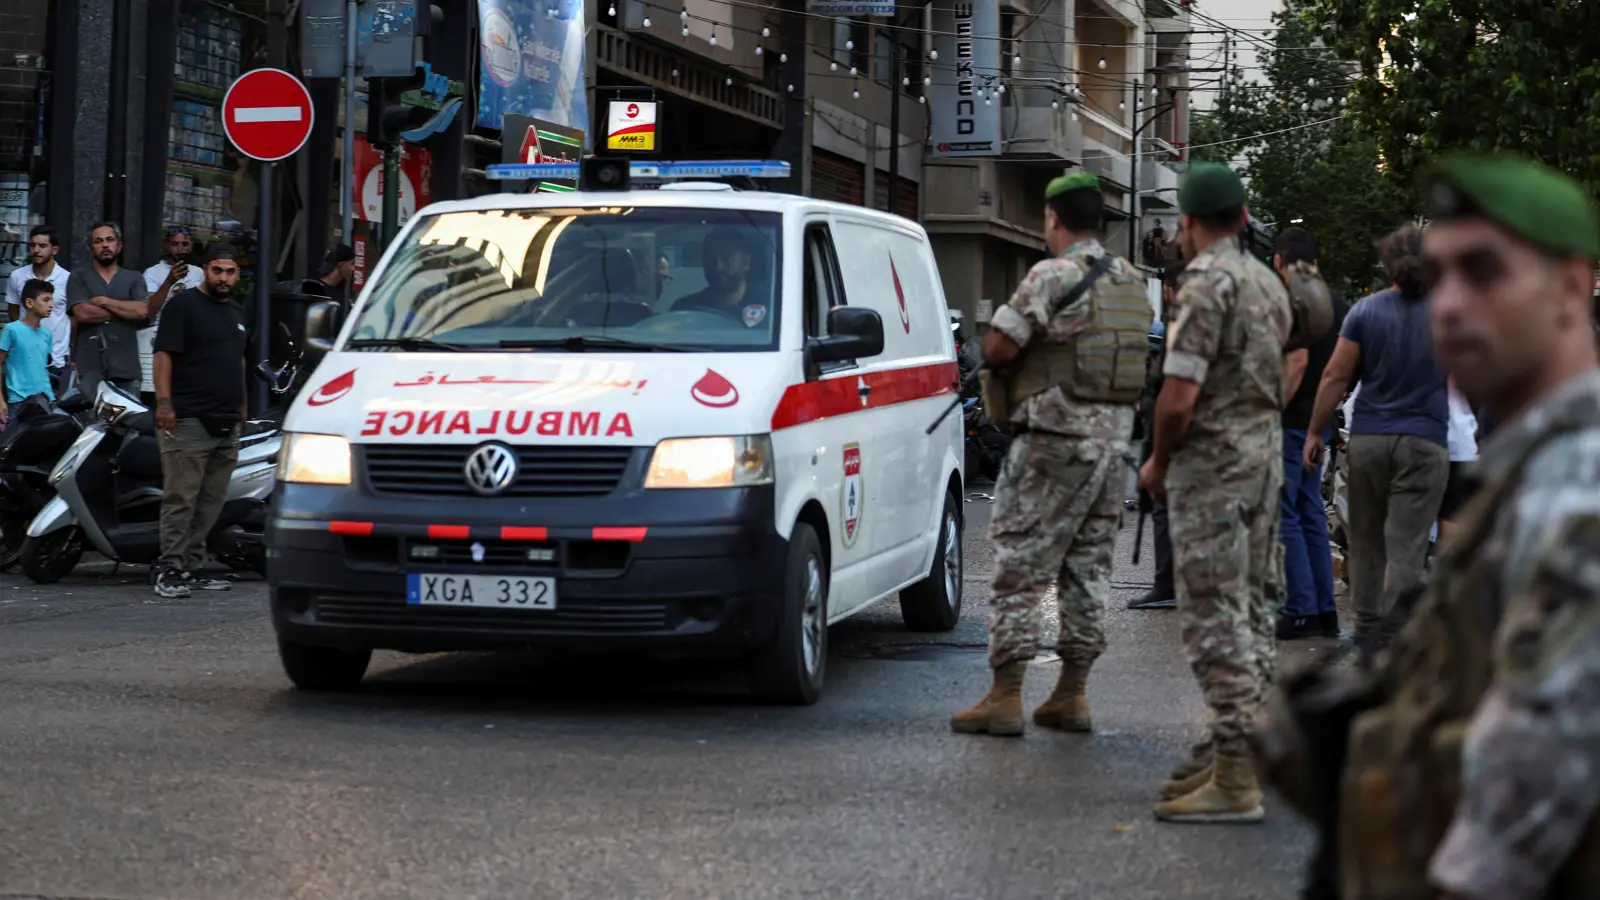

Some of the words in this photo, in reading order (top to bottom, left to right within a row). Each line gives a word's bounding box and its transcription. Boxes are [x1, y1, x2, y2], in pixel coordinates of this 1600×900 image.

[954, 2, 975, 136] WEEKEND
[424, 576, 475, 603] XGA
[497, 579, 548, 606] 332
